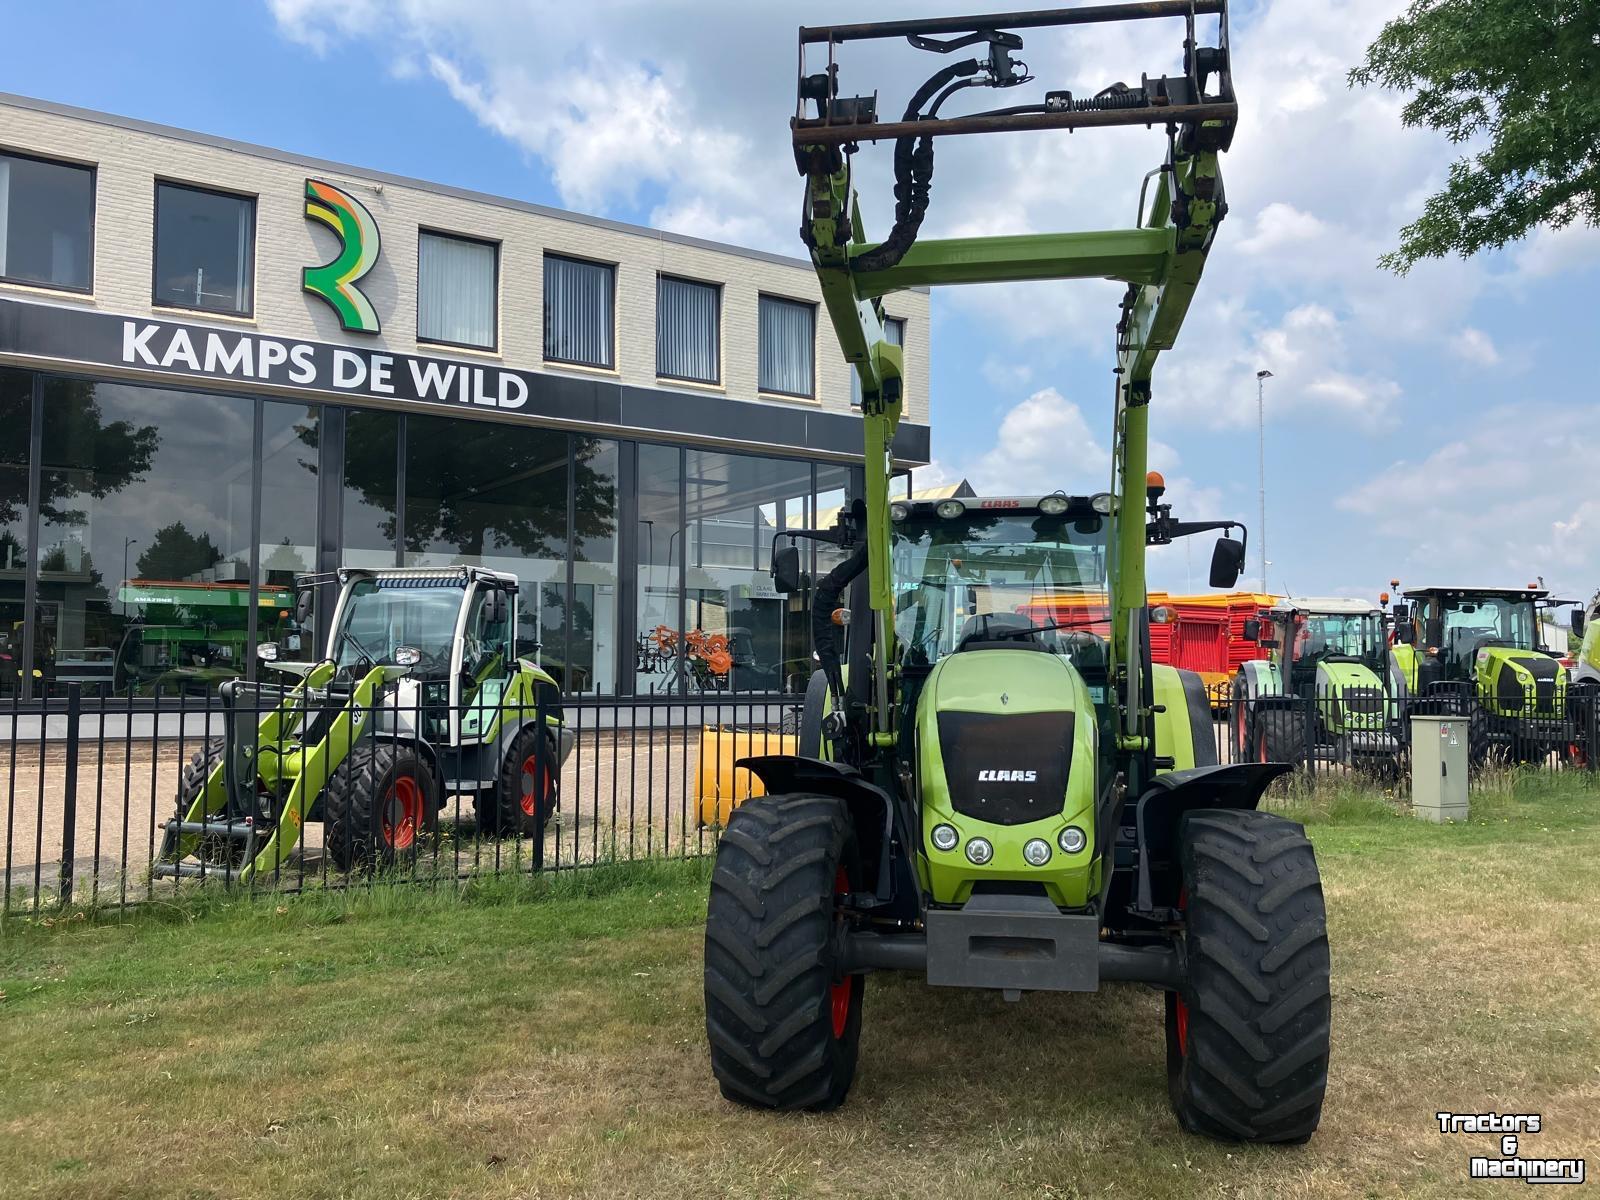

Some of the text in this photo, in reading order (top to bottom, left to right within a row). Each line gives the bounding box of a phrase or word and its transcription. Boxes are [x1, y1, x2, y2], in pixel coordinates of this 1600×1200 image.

[122, 321, 528, 409] KAMPS DE WILD
[981, 500, 1020, 508] CLAAS
[978, 770, 1037, 782] CLAAS
